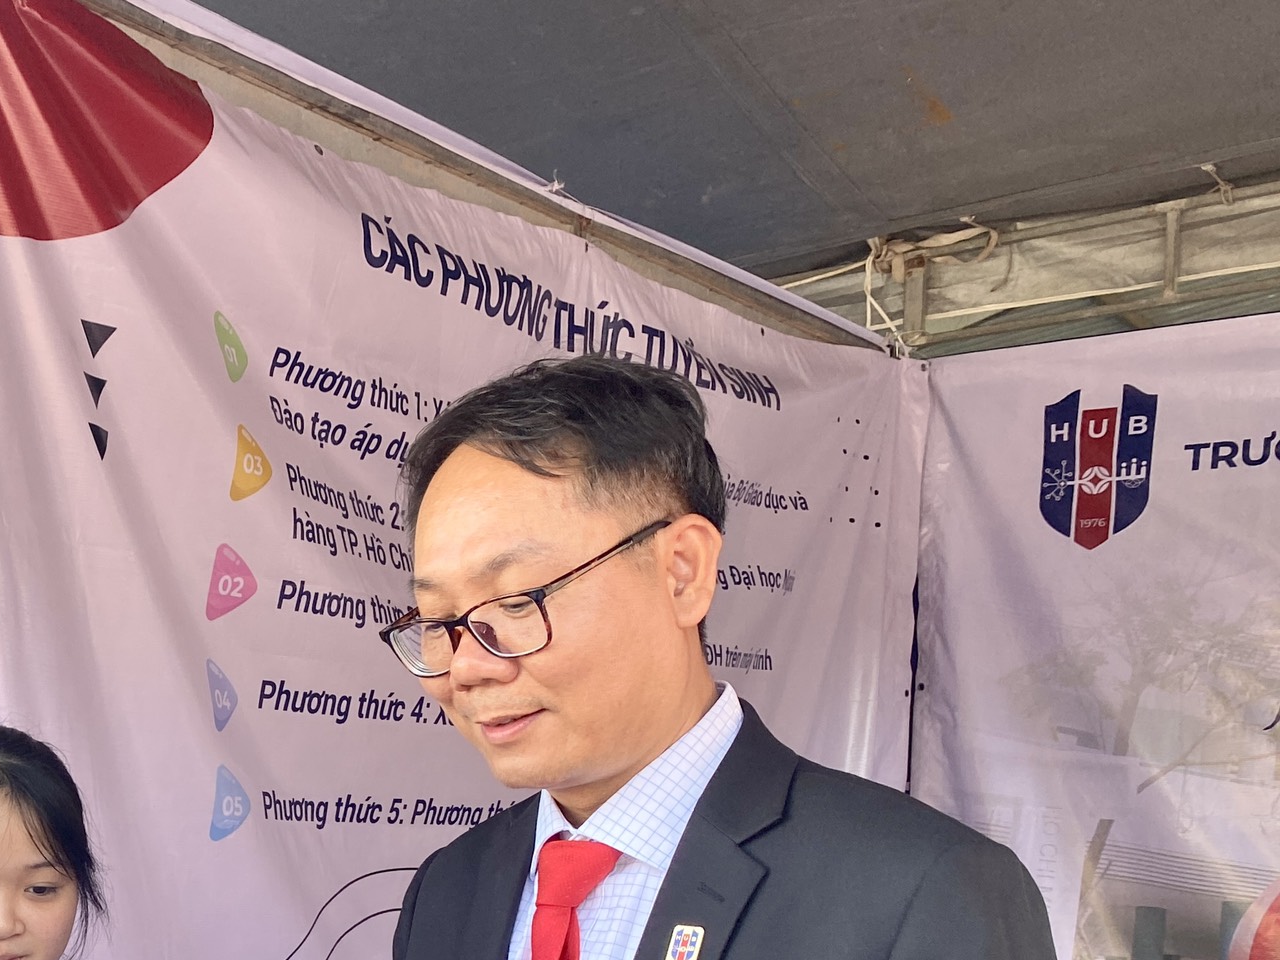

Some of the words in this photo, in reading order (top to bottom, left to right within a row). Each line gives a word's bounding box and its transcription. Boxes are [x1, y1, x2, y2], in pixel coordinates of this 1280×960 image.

[361, 212, 434, 287] CÁC
[435, 244, 552, 341] PHƯƠNG
[554, 297, 635, 362] THỨC
[718, 363, 781, 411] SINH
[269, 347, 365, 410] Phương
[370, 377, 409, 417] thức
[269, 395, 304, 436] Đào
[311, 412, 347, 448] tạo
[350, 423, 382, 460] áp
[243, 454, 263, 477] 03
[1184, 431, 1280, 471] TRƯ
[285, 462, 349, 519] Phương
[350, 489, 385, 526] thức
[765, 486, 787, 514] dục
[789, 491, 809, 510] và
[292, 507, 337, 557] hàng
[336, 524, 362, 559] TP.
[363, 533, 387, 566] Hồ
[1079, 518, 1106, 528] 1976
[218, 574, 245, 598] 02
[729, 565, 756, 590] Đại
[757, 565, 782, 593] học
[277, 579, 366, 628] Phương
[215, 689, 231, 709] 04
[258, 680, 352, 725] Phương
[358, 689, 406, 722] thức
[410, 696, 431, 723] 4:
[222, 795, 243, 816] 05
[261, 790, 328, 830] Phương
[334, 794, 382, 824] thức
[388, 798, 408, 825] 5:
[410, 799, 482, 827] Phương
